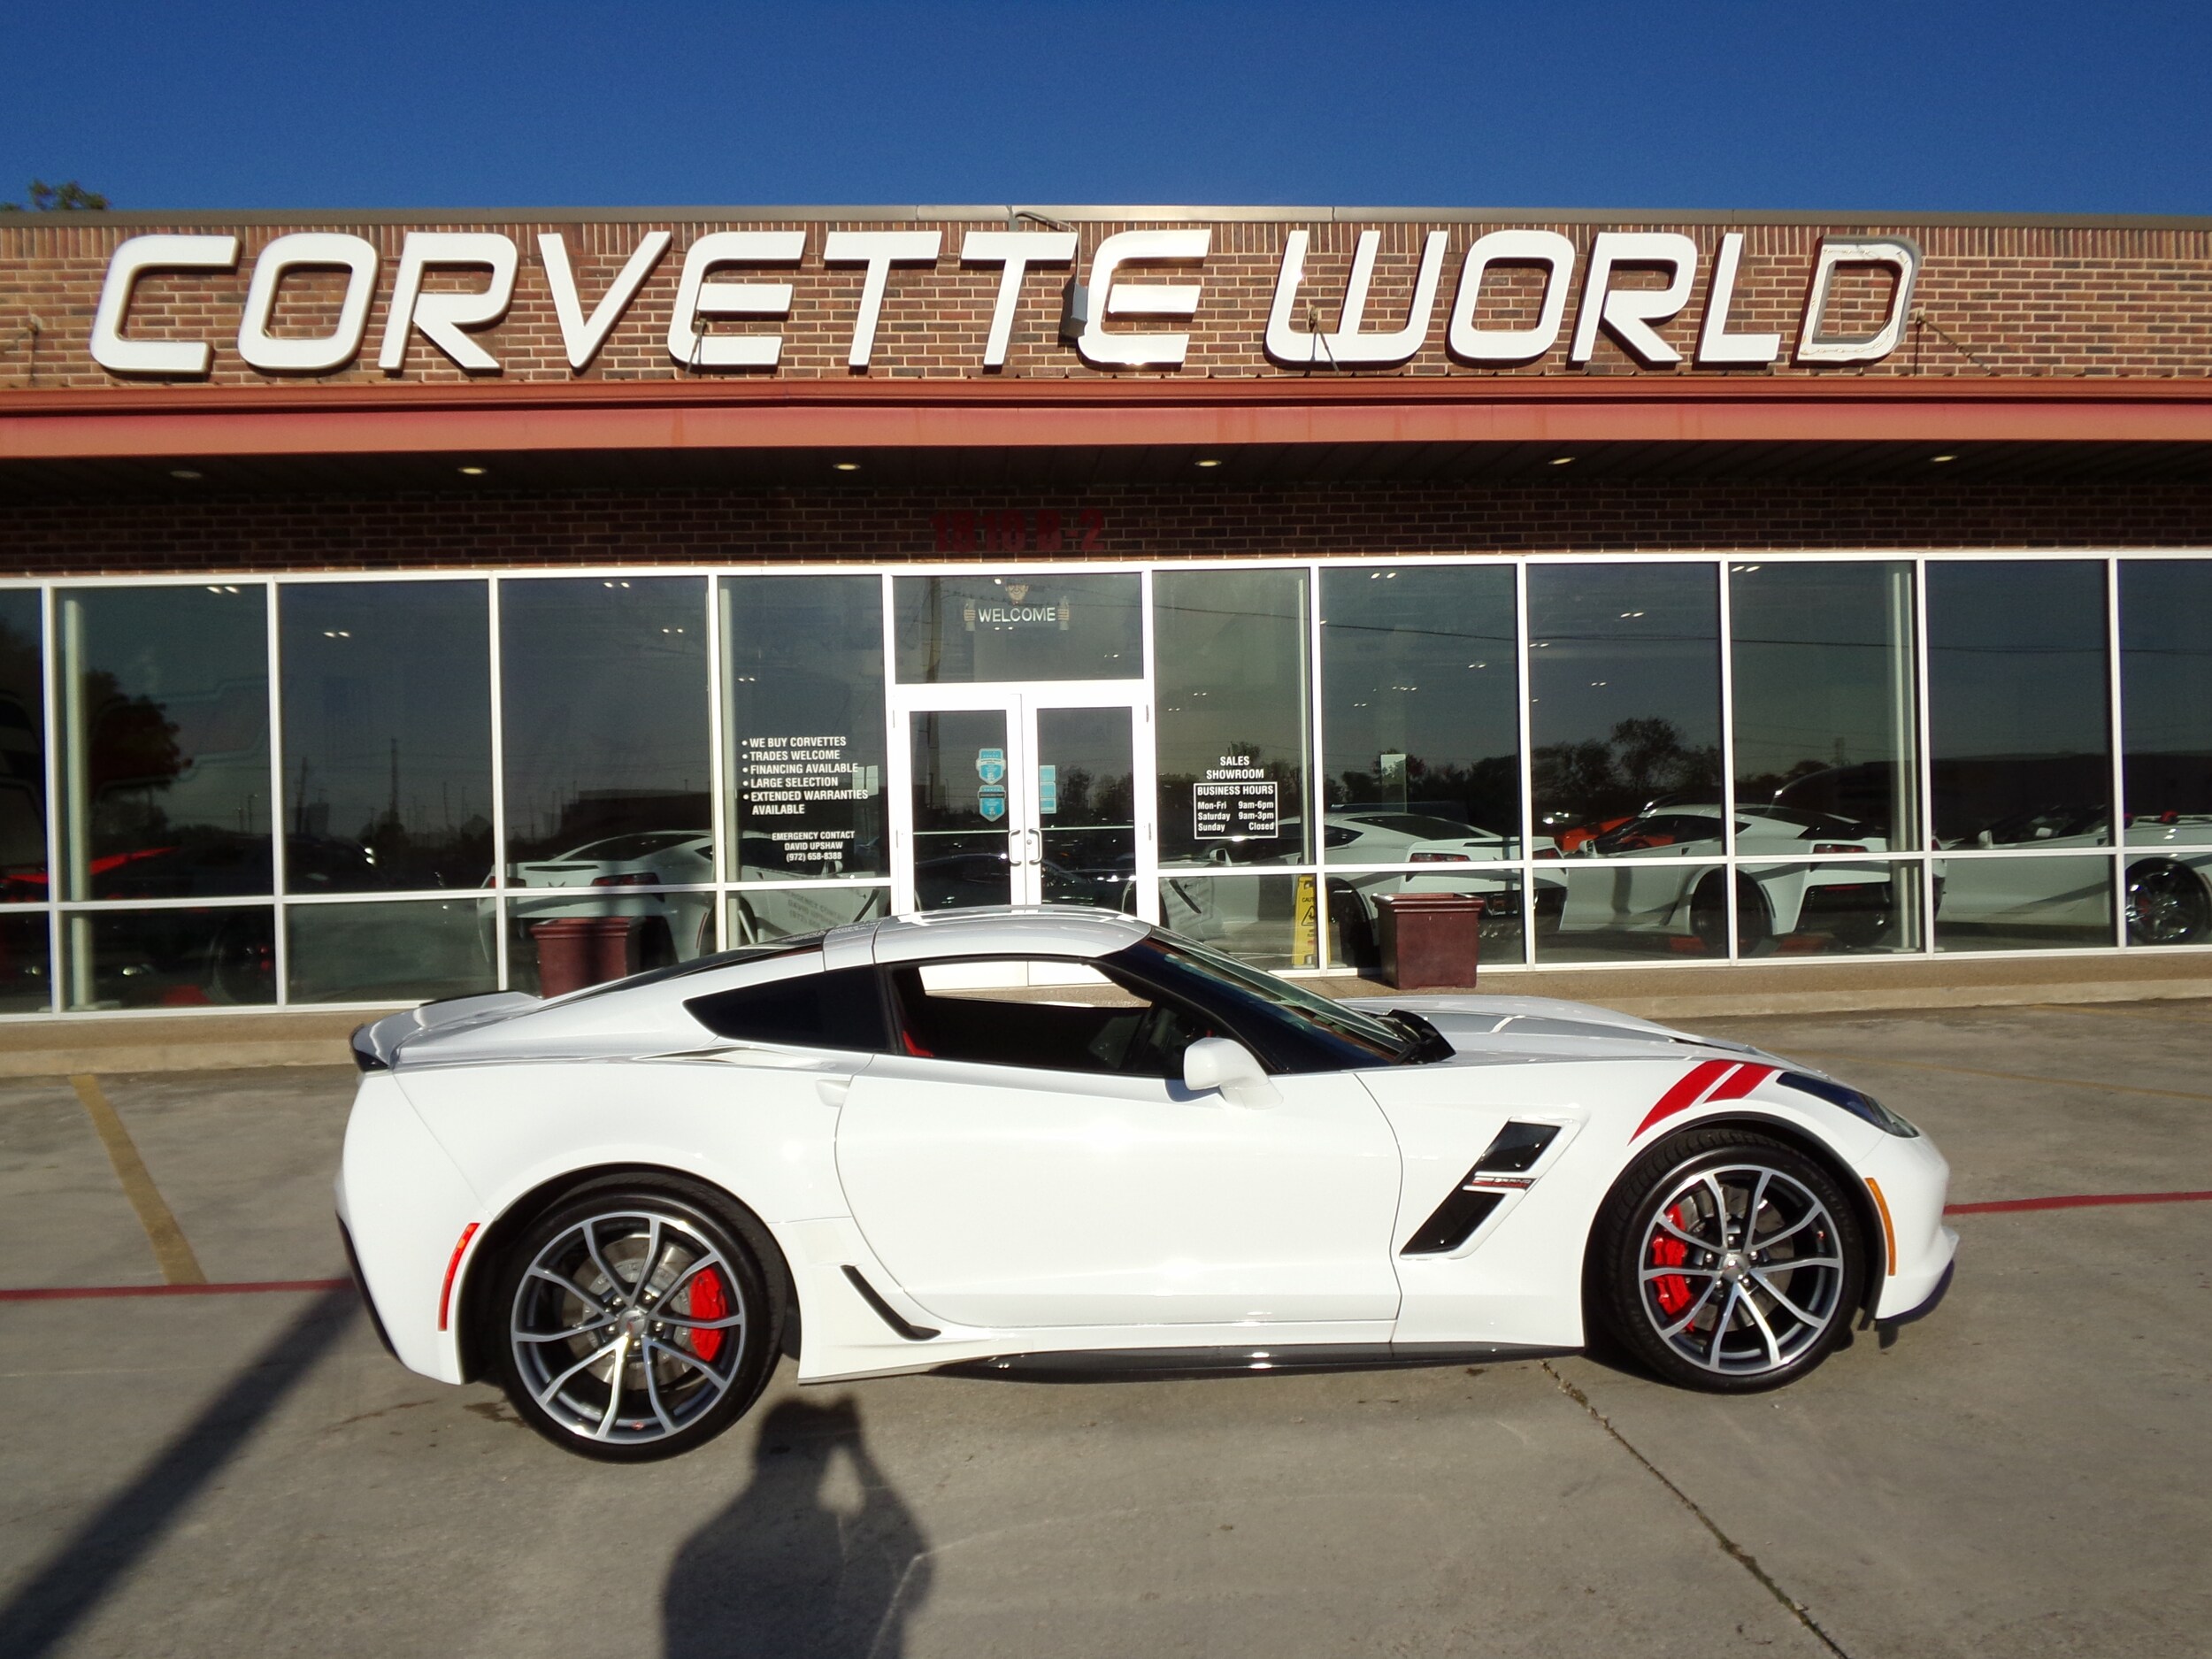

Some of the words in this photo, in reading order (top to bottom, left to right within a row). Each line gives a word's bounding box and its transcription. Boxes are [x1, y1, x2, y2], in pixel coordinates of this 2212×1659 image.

[89, 229, 1212, 375] CORVETTE
[1263, 229, 1918, 365] WORLD
[978, 608, 1056, 622] WELCOME
[750, 738, 765, 748] WE
[768, 738, 787, 747] BUY
[790, 736, 846, 747] CORVETTES
[750, 751, 787, 761] TRADES
[791, 750, 840, 760] WELCOME
[1220, 756, 1249, 766] SALES
[750, 764, 803, 774] FINANCING
[806, 763, 858, 773] AVAILABLE
[1206, 769, 1264, 780] SHOWROOM
[751, 778, 782, 787] LARGE
[786, 777, 838, 787] SELECTION
[1197, 787, 1240, 795] BUSINESS
[1243, 786, 1273, 795] HOURS
[751, 791, 802, 802] EXTENDED
[804, 790, 868, 800] WARRANTIES
[752, 804, 805, 815] AVAILABLE
[1238, 801, 1274, 810] 9am-6pm
[1198, 812, 1231, 821] Saturday
[1239, 811, 1274, 821] 9am-3pm
[1198, 823, 1225, 833] Sunday
[772, 832, 818, 841] EMERGENCY
[785, 842, 808, 851] DAVID
[810, 841, 843, 850] UPSHAW
[787, 853, 806, 862] (972)
